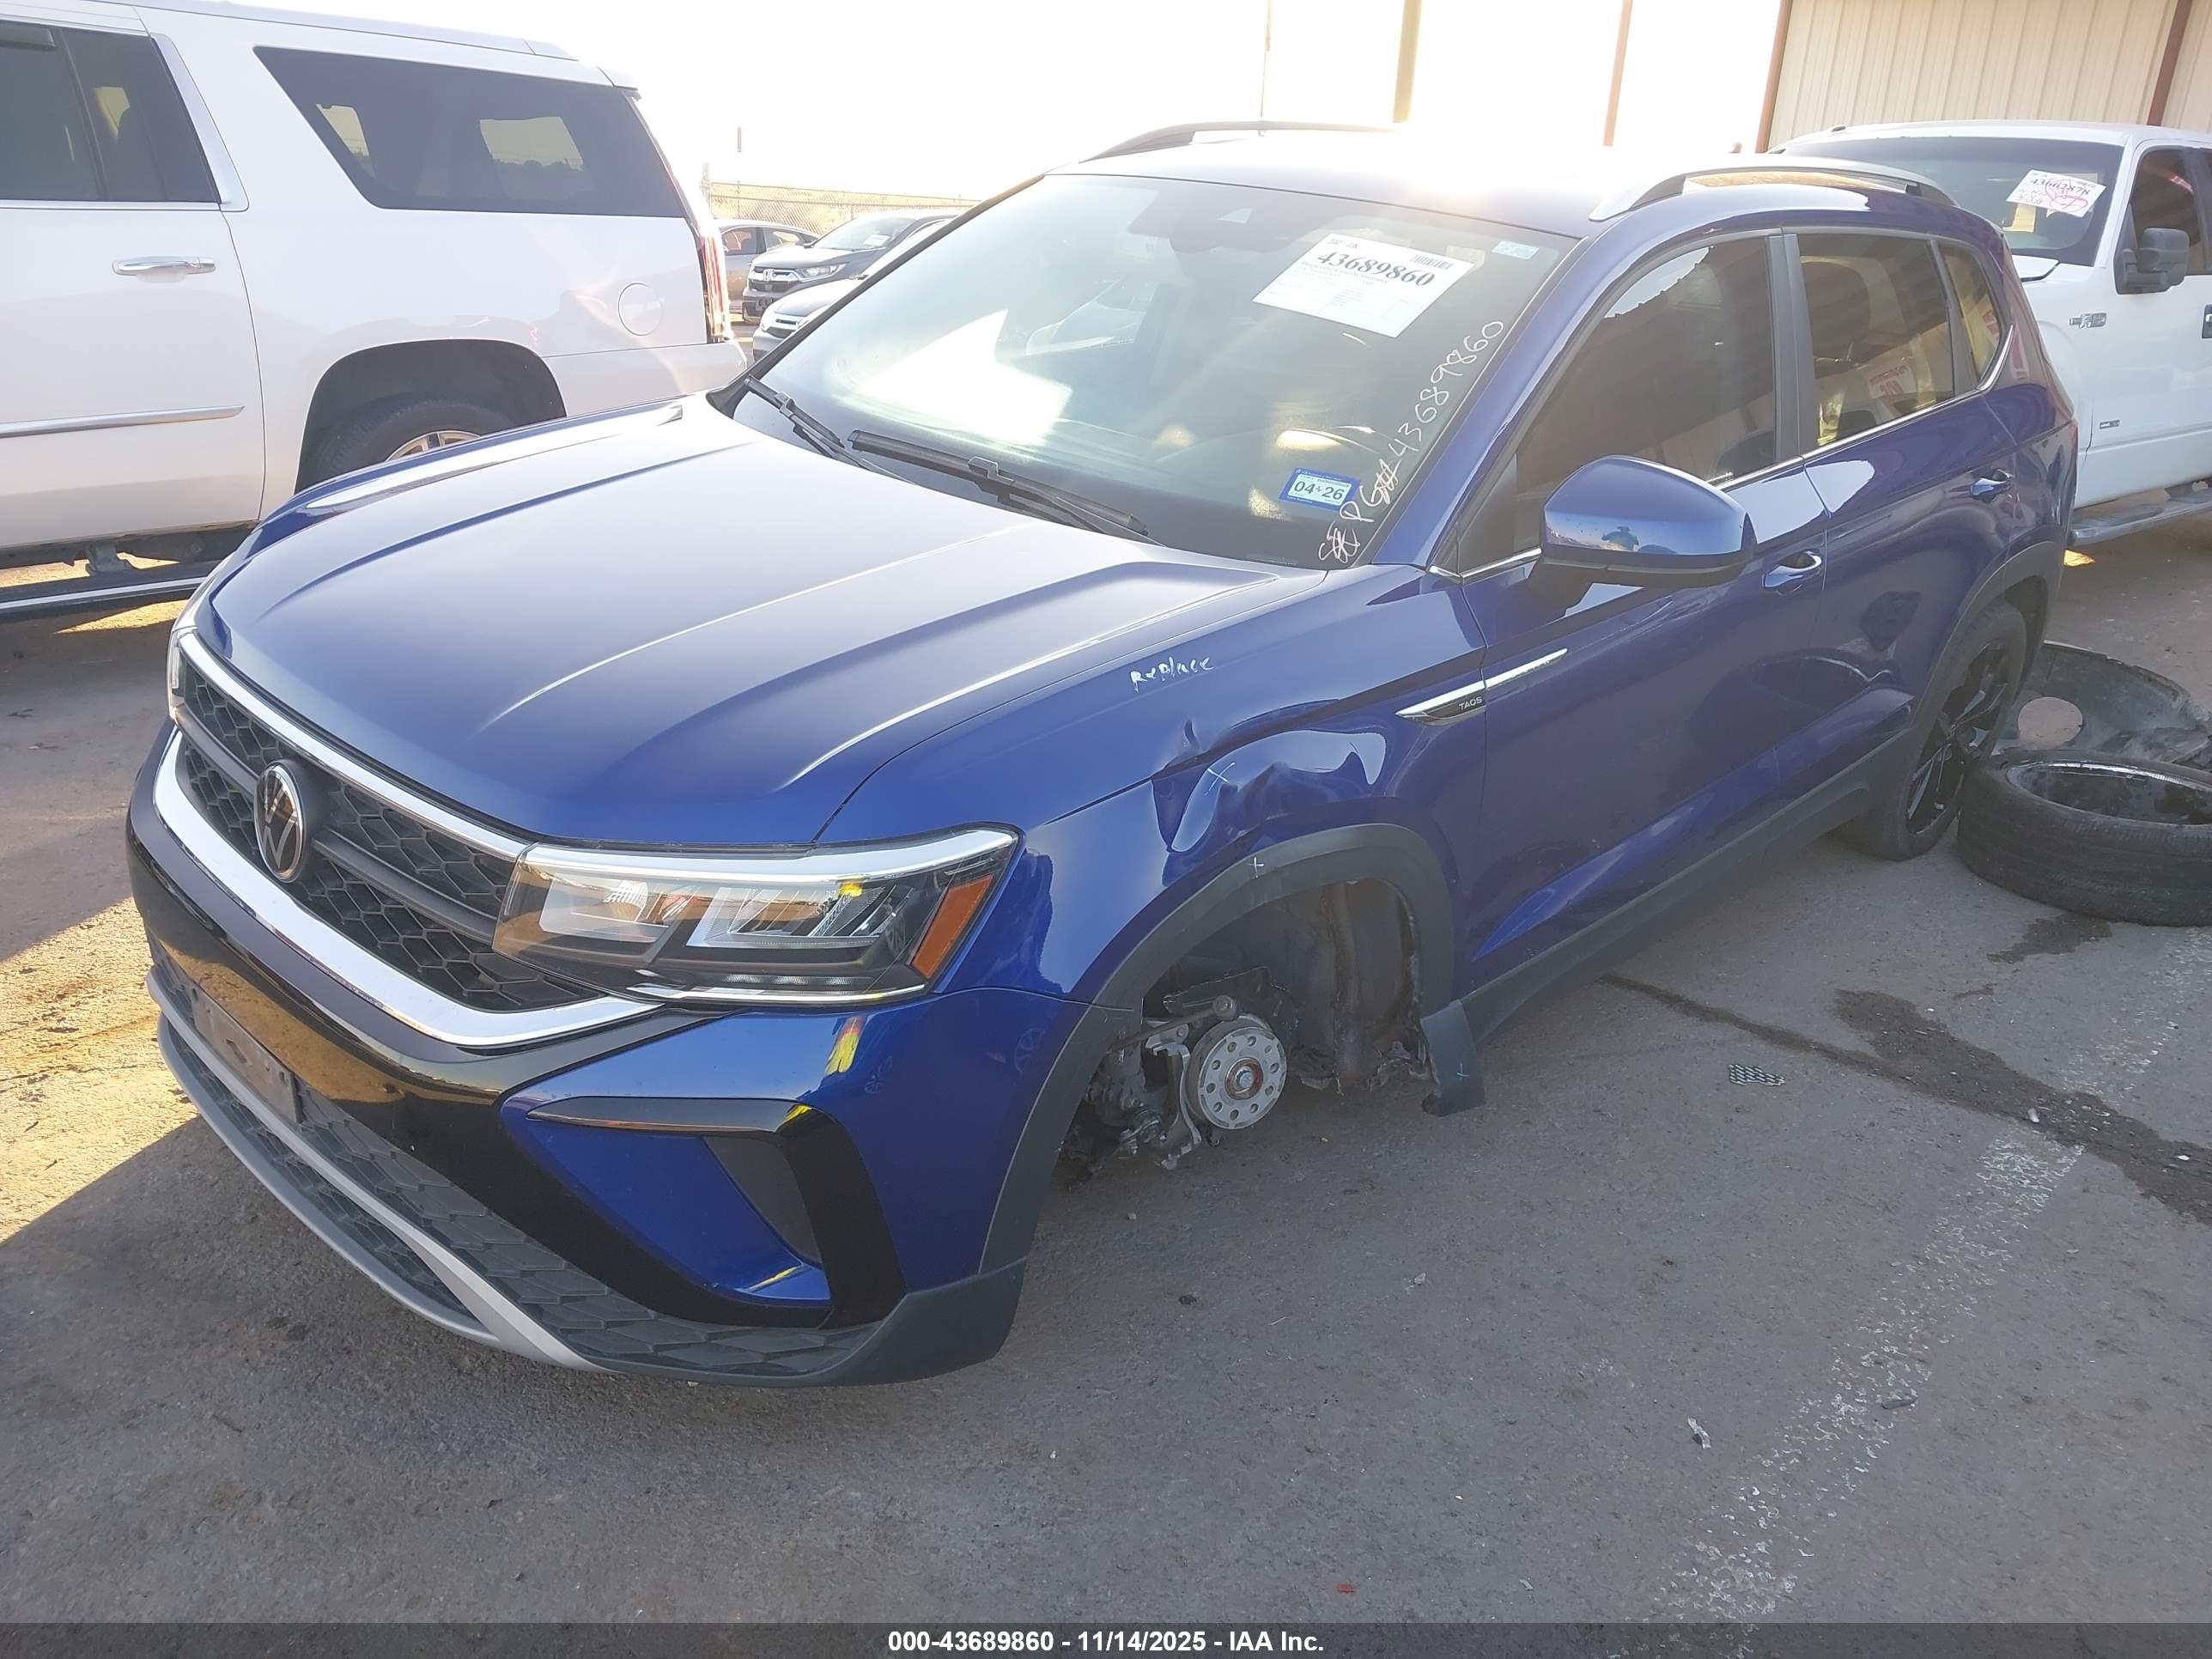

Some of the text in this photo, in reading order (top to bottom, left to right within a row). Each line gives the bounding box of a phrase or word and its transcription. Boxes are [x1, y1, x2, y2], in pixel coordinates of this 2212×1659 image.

[1317, 251, 1436, 287] 43689860
[1389, 321, 1504, 457] 43689860
[1294, 481, 1316, 495] 04
[1322, 486, 1345, 500] 26
[1458, 696, 1483, 711] TAOS
